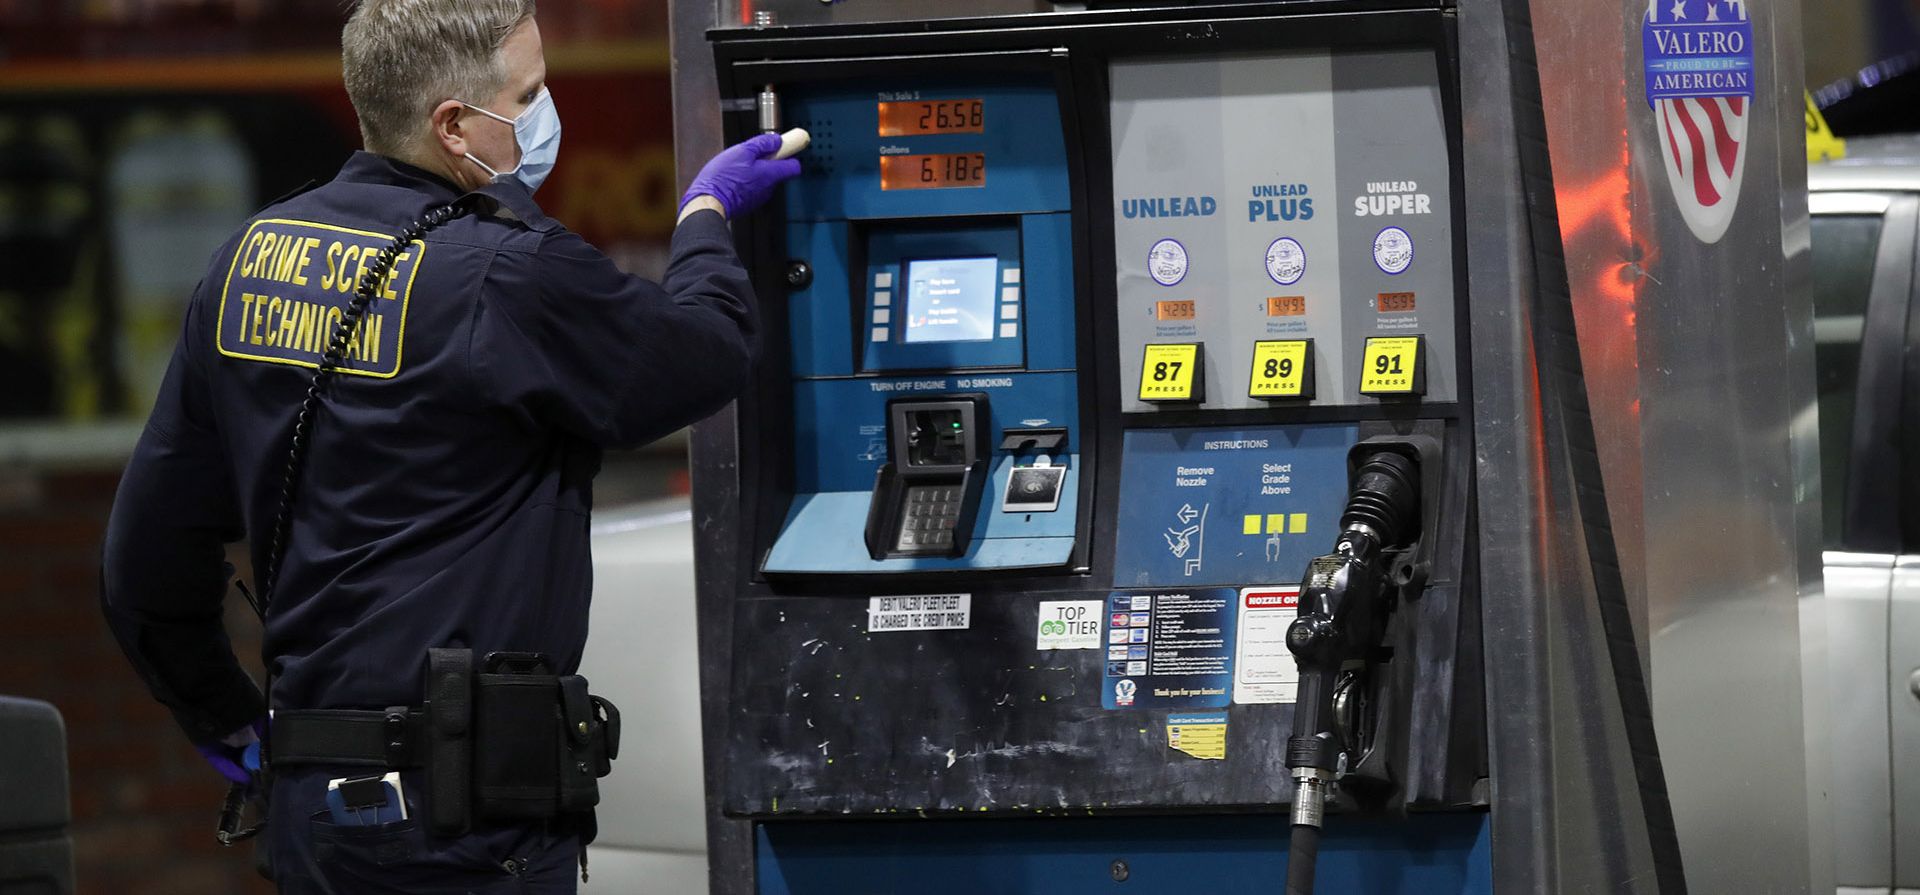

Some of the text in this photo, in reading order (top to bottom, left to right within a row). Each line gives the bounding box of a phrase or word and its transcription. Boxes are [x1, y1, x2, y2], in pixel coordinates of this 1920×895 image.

[1653, 30, 1744, 55] VALERO
[1666, 59, 1736, 70] PROUD TO BE
[1654, 72, 1748, 90] AMERICAN
[878, 92, 894, 101] This
[896, 92, 912, 101] Sale
[920, 102, 982, 129] 26.58
[880, 146, 910, 155] Gallons
[921, 156, 985, 182] 6.182
[1252, 184, 1308, 197] UNLEAD
[1367, 181, 1417, 194] UNLEAD
[1122, 196, 1217, 219] UNLEAD
[1248, 198, 1314, 222] PLUS
[1354, 194, 1432, 217] SUPER
[240, 231, 412, 300] CRIME SCEE
[1369, 299, 1374, 307] $
[239, 293, 384, 363] TECHNICAN
[1264, 358, 1293, 378] 89
[1375, 354, 1403, 374] 91
[1153, 362, 1182, 381] 87
[870, 380, 946, 391] TURN OFF ENGINE
[957, 378, 1013, 388] NO SMOKING
[1204, 440, 1269, 450] INSTRUCTIONS
[1176, 466, 1214, 476] Remove
[1262, 463, 1291, 473] Select
[1176, 478, 1207, 487] Nozzle
[1262, 474, 1290, 484] Grade
[1261, 486, 1290, 495] Above
[1248, 597, 1282, 605] NOZZLE
[1057, 606, 1086, 620] TOP
[1068, 621, 1098, 635] TIER
